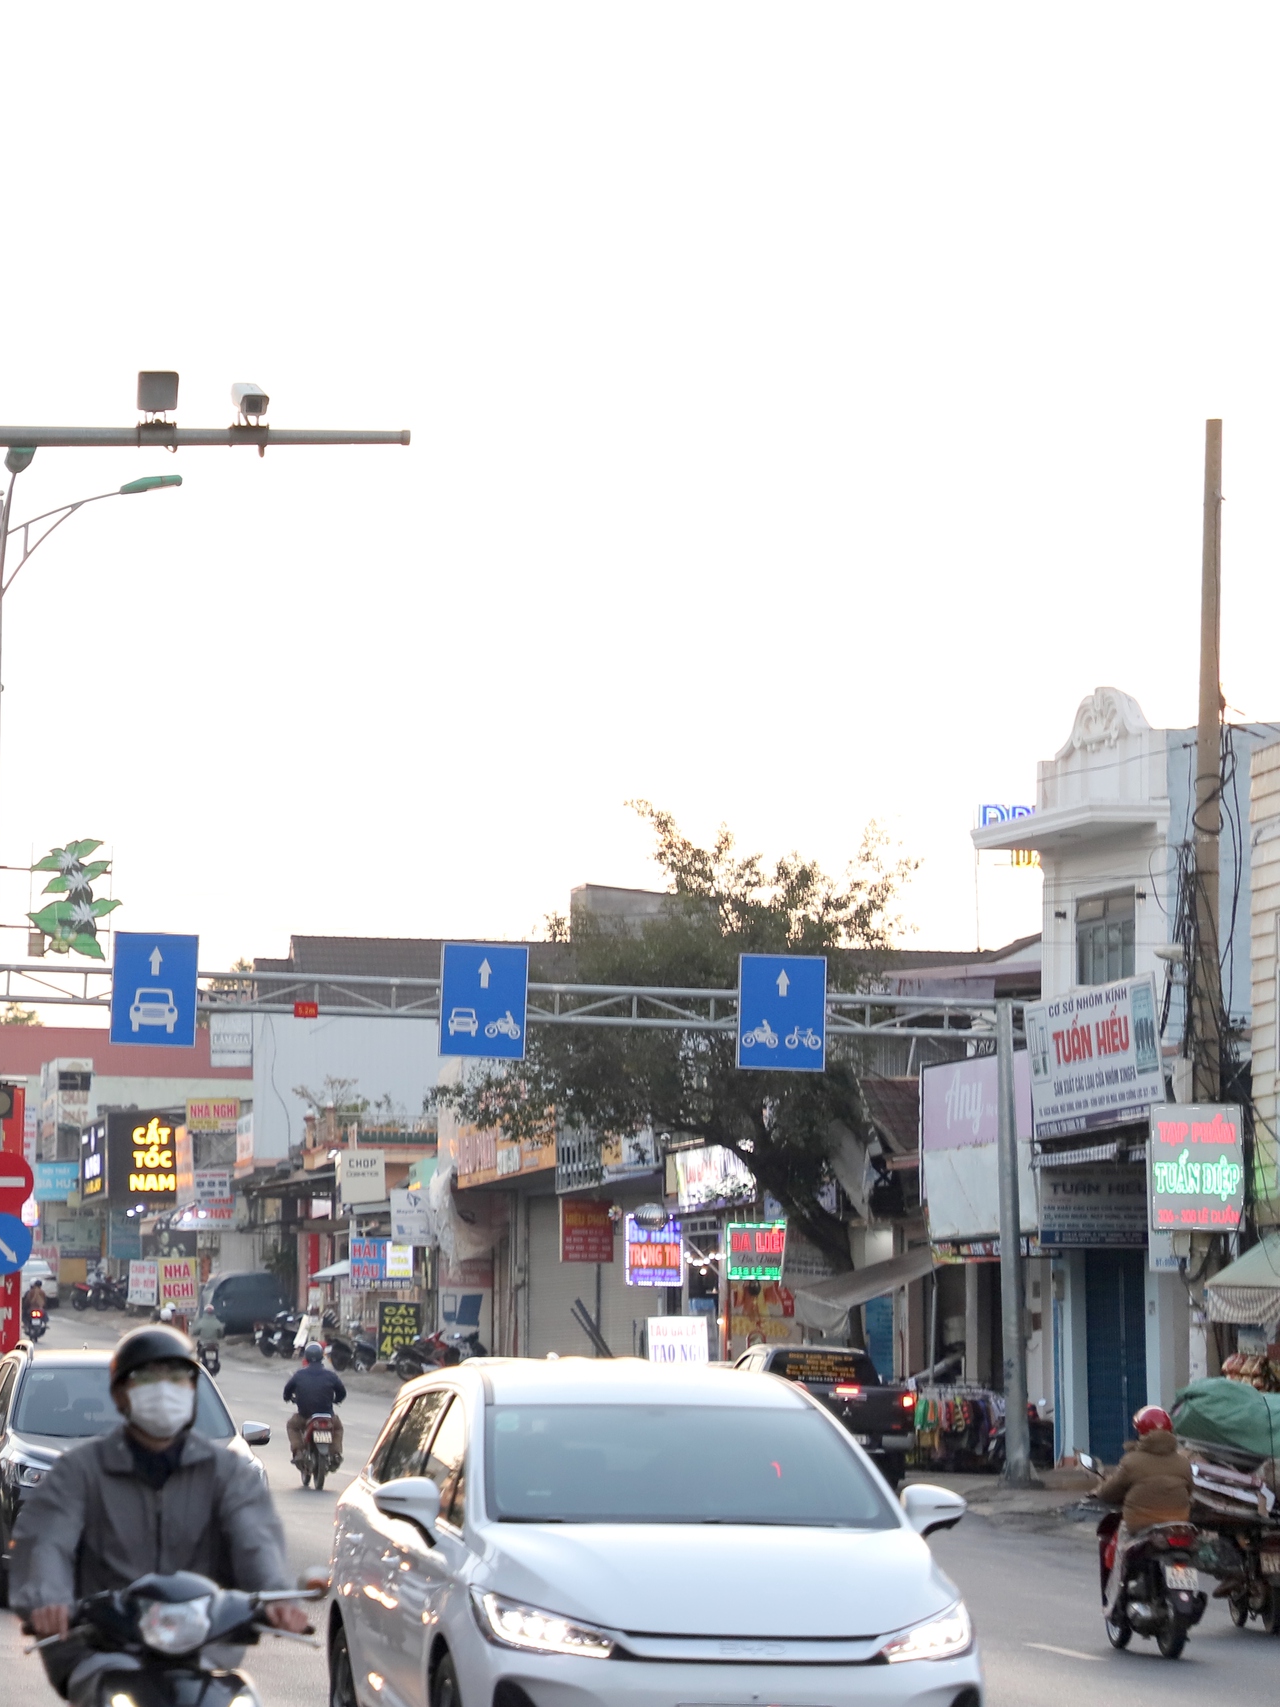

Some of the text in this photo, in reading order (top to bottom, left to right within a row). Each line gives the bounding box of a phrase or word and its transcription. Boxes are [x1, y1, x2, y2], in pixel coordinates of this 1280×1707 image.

[1048, 986, 1127, 1018] CƠ SỞ NHÔM KÍNH
[1052, 1004, 1130, 1065] TUẤN HIẾU
[190, 1102, 211, 1119] NHÀ
[945, 1069, 983, 1136] Any
[132, 1117, 171, 1145] CẮT
[1158, 1121, 1189, 1147] TẠP
[132, 1144, 173, 1169] TÓC
[348, 1158, 377, 1169] CHOP
[129, 1173, 176, 1192] NAM
[1155, 1148, 1240, 1202] TUẤN ĐIỆP
[1198, 1206, 1209, 1223] LÊ
[352, 1239, 377, 1259] HẢI
[731, 1232, 752, 1252] DA
[629, 1244, 663, 1269] TRỌNG
[664, 1241, 680, 1266] TÍN
[163, 1261, 191, 1279] NHÀ
[352, 1261, 379, 1278] HÀU
[163, 1278, 194, 1298] NGHỈ
[384, 1304, 416, 1316] CẮT
[381, 1325, 418, 1334] NAM
[383, 1315, 416, 1326] TÓC
[651, 1344, 676, 1363] TAO
